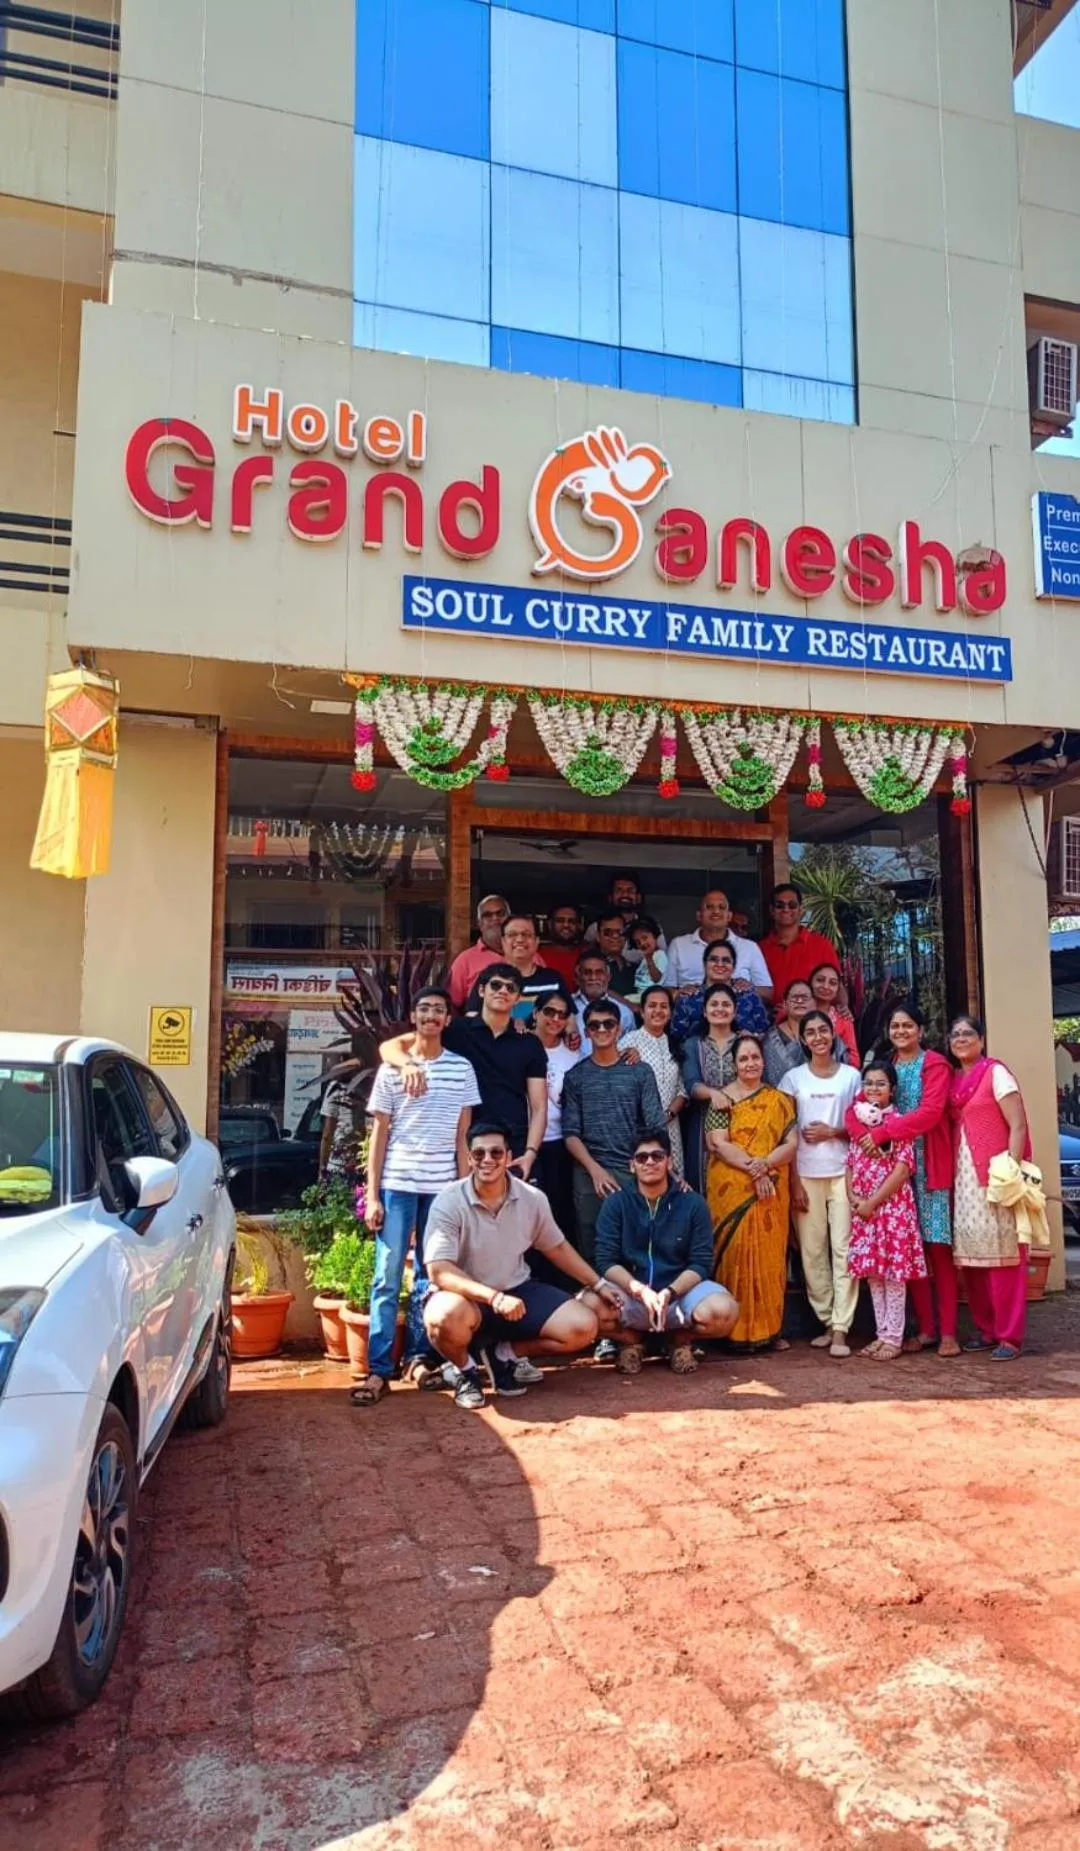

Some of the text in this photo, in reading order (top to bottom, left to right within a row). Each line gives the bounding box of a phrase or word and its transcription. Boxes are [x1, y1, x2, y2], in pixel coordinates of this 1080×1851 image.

[232, 383, 427, 468] Hotel
[124, 416, 501, 561] Grand
[1043, 535, 1080, 554] Exec
[410, 585, 1006, 673] SOUL CURRY FAMILY RESTAURANT
